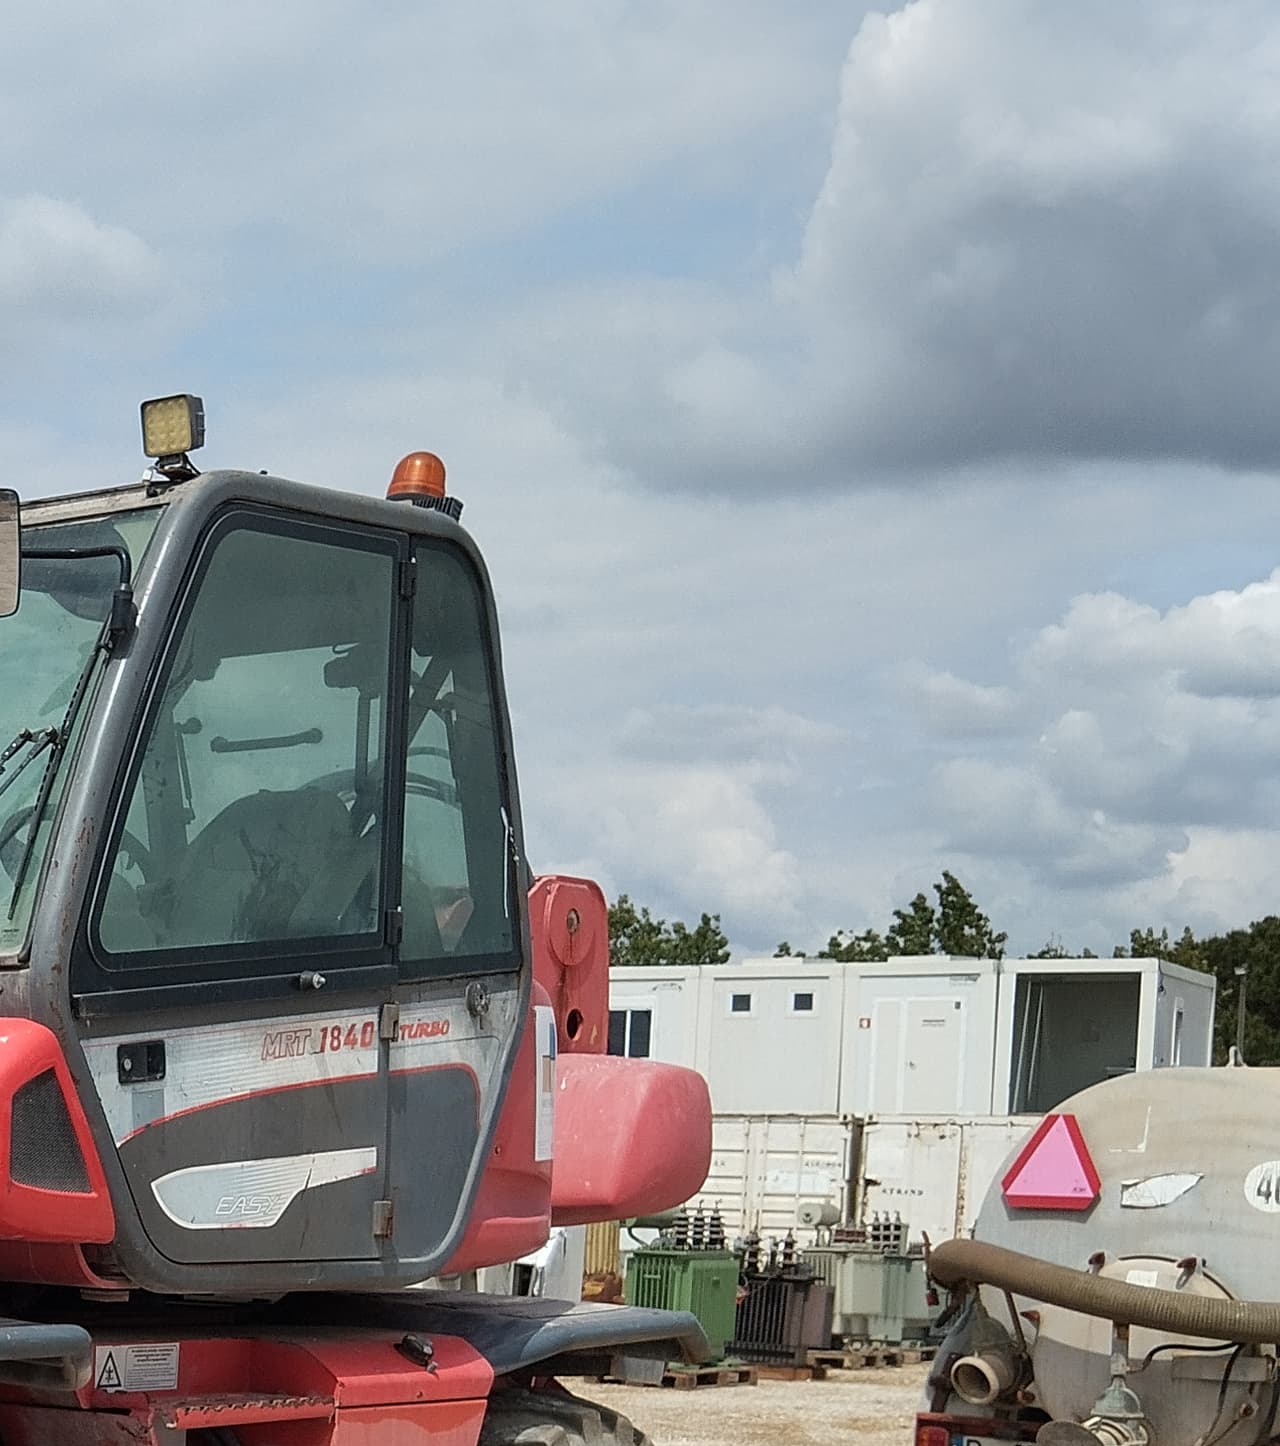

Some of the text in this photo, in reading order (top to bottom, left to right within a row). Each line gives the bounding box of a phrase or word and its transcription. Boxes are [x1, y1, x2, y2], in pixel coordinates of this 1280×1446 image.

[261, 1019, 450, 1061] MRT 1840 TURBO
[215, 1195, 278, 1215] EASY
